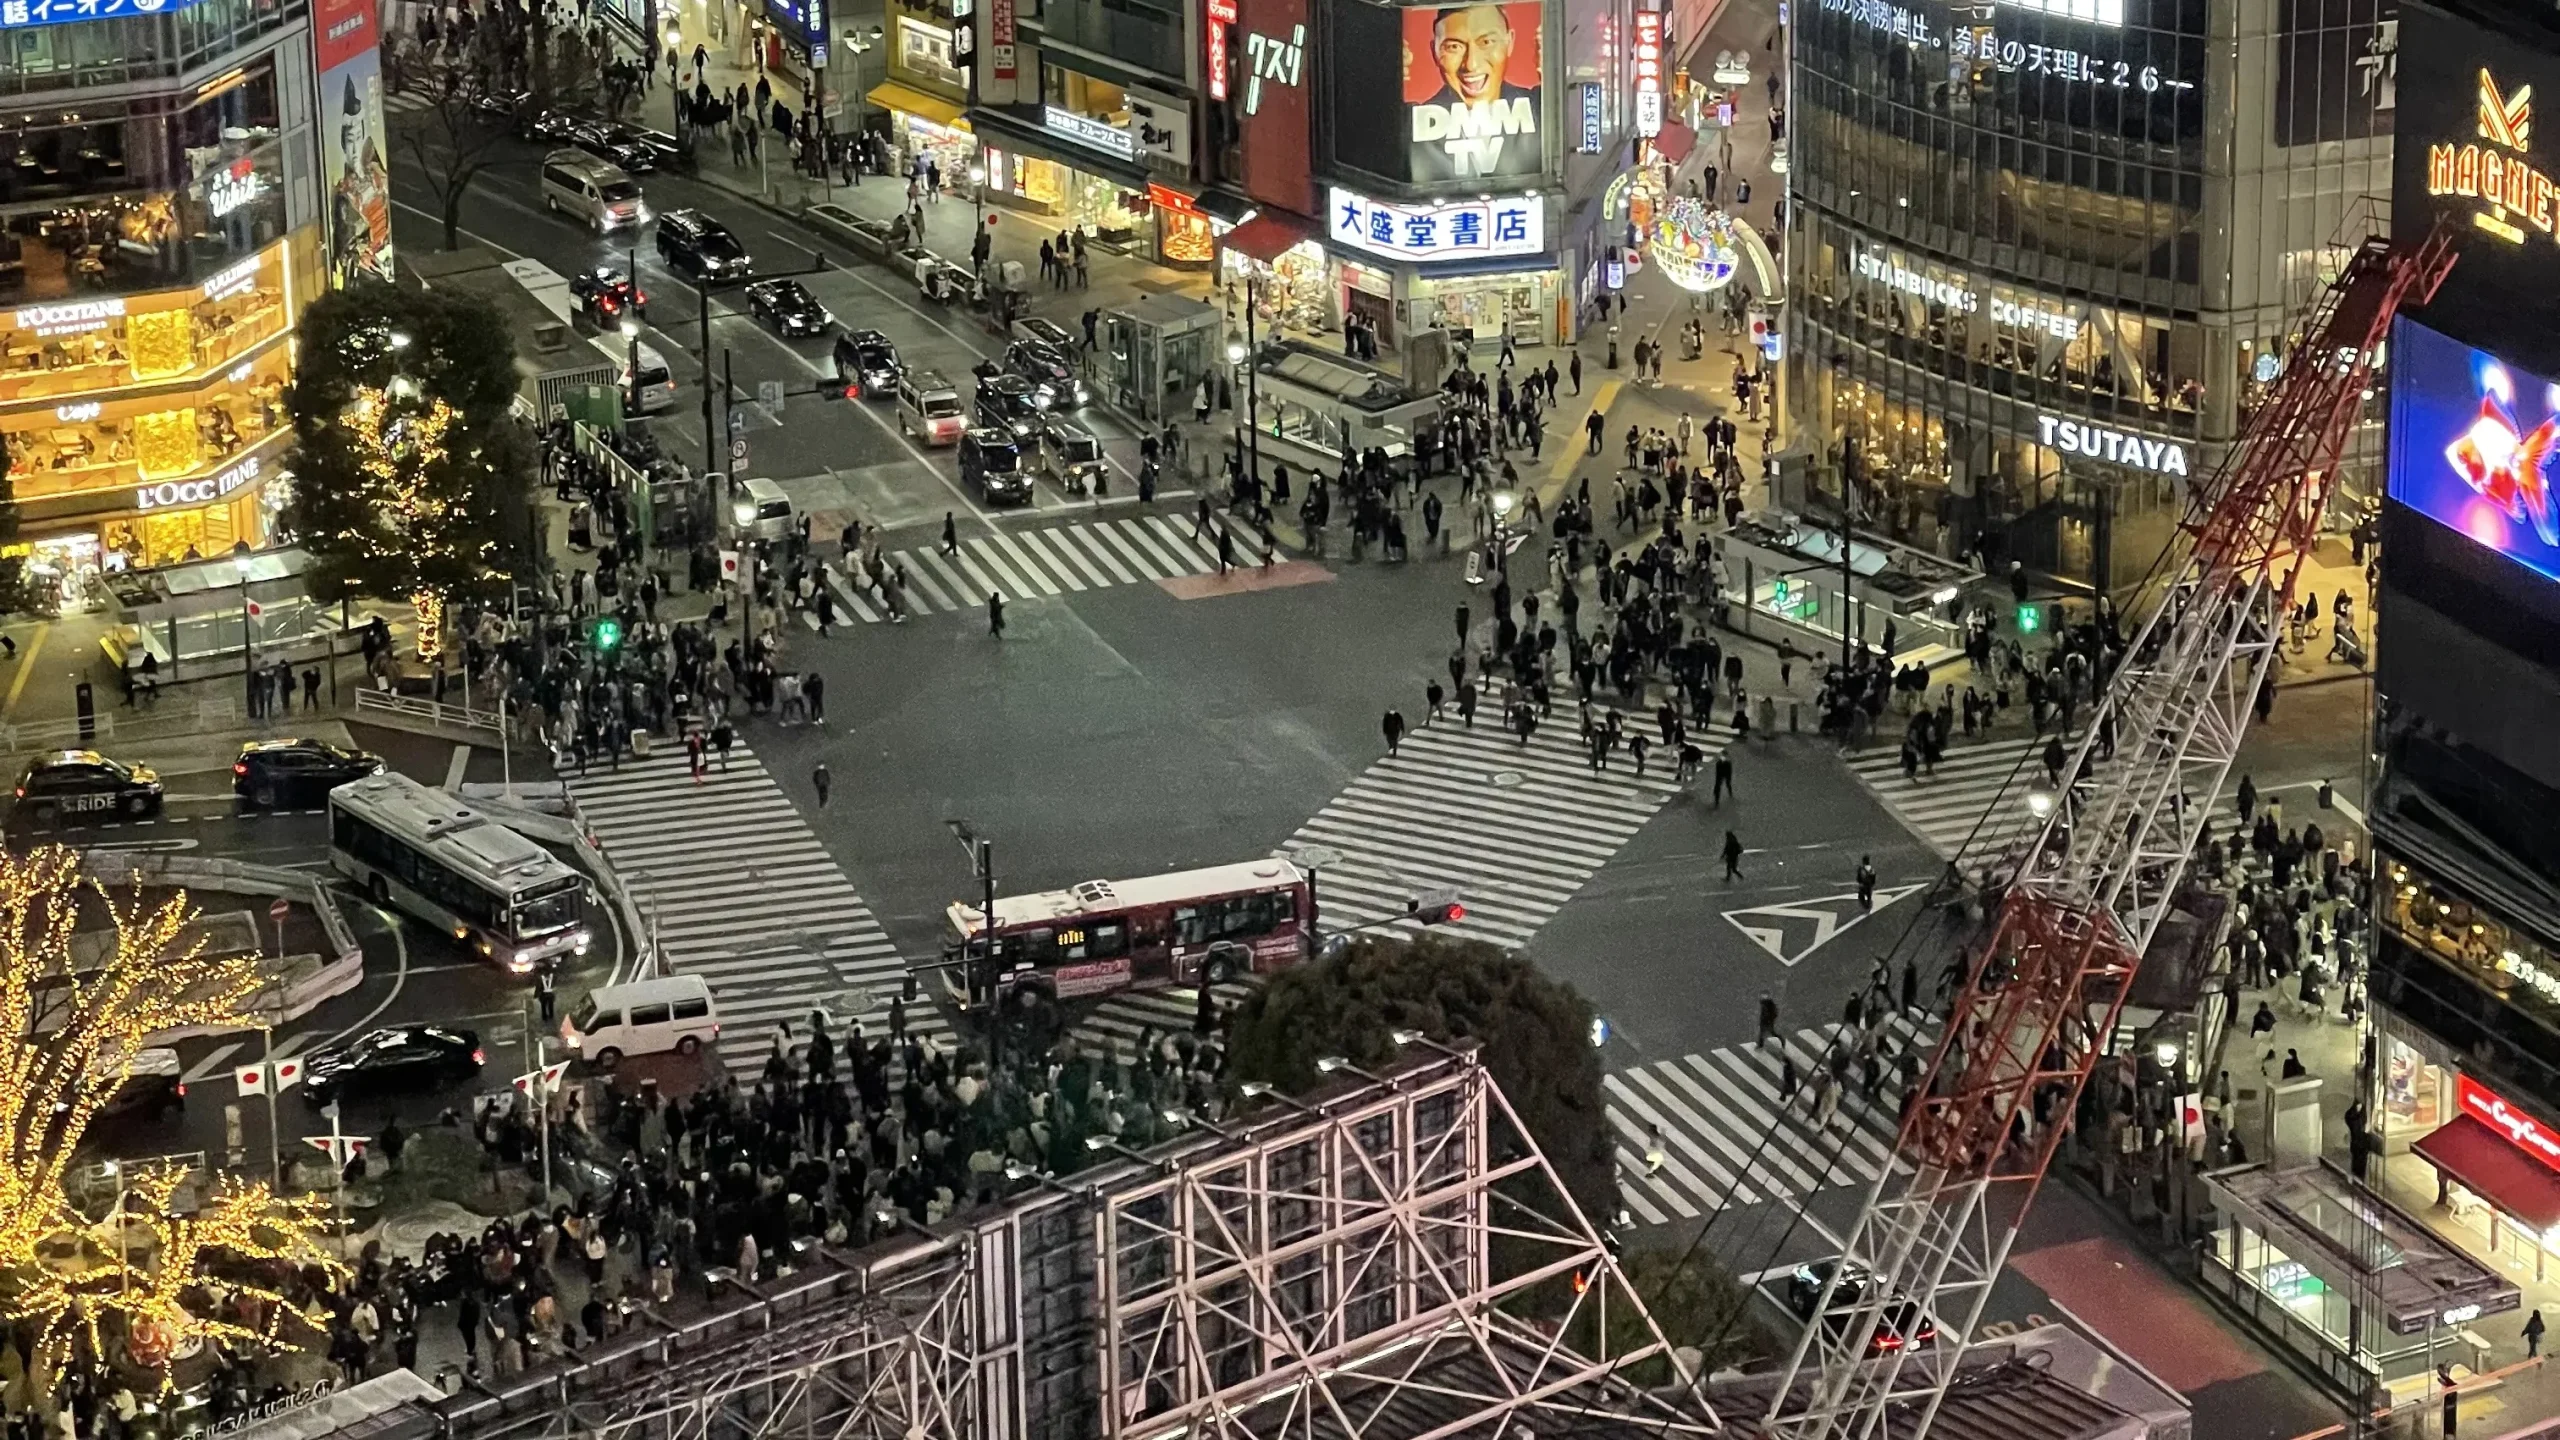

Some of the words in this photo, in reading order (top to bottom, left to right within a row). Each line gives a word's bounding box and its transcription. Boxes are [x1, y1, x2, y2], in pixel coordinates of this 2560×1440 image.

[1412, 97, 1536, 142] DMM
[1444, 136, 1505, 178] TV
[1341, 200, 1528, 248] 大盛堂書店
[16, 299, 126, 329] L'OCCITANE
[1858, 252, 1978, 314] STARBUCKS
[1990, 297, 2079, 340] COFFEE
[2038, 414, 2188, 477] TSUTAYA
